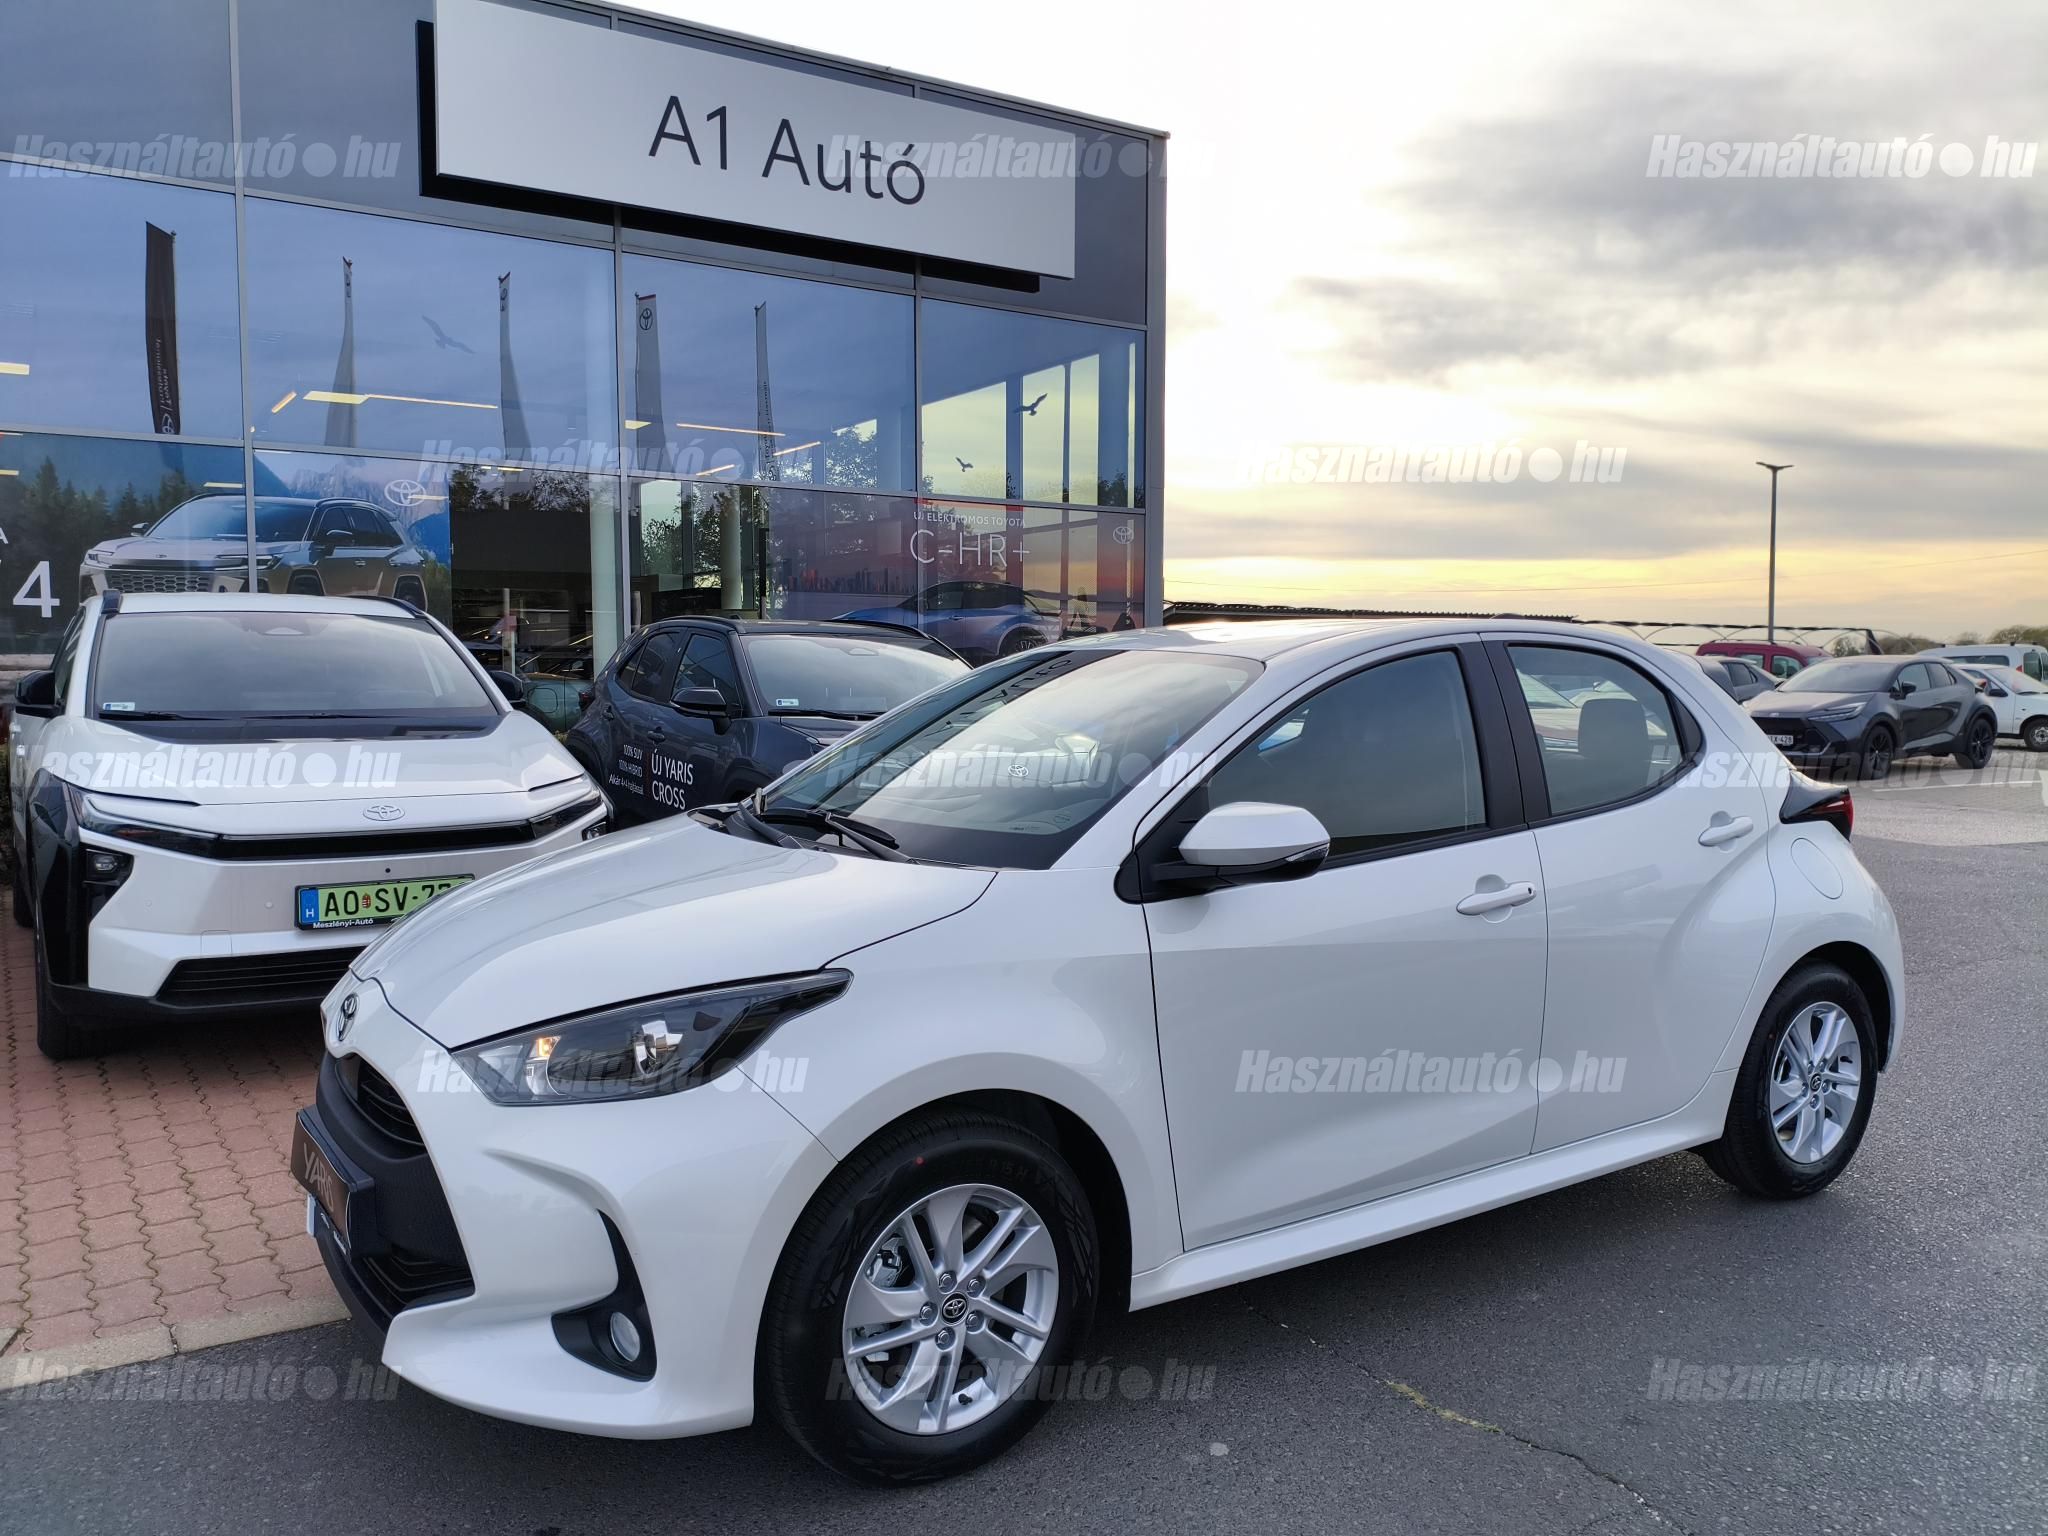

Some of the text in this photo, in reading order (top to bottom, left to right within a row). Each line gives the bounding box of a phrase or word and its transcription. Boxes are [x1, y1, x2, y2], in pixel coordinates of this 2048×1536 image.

[649, 95, 925, 205] A1 Autó
[927, 512, 989, 525] ELEKTROMOS
[992, 516, 1026, 528] TOYOTA
[910, 529, 1030, 567] C-HR+
[651, 748, 694, 785] ÚJ YARIS
[651, 780, 686, 810] CROSS
[305, 908, 314, 918] H
[312, 917, 374, 929] Meszlényi-Autó
